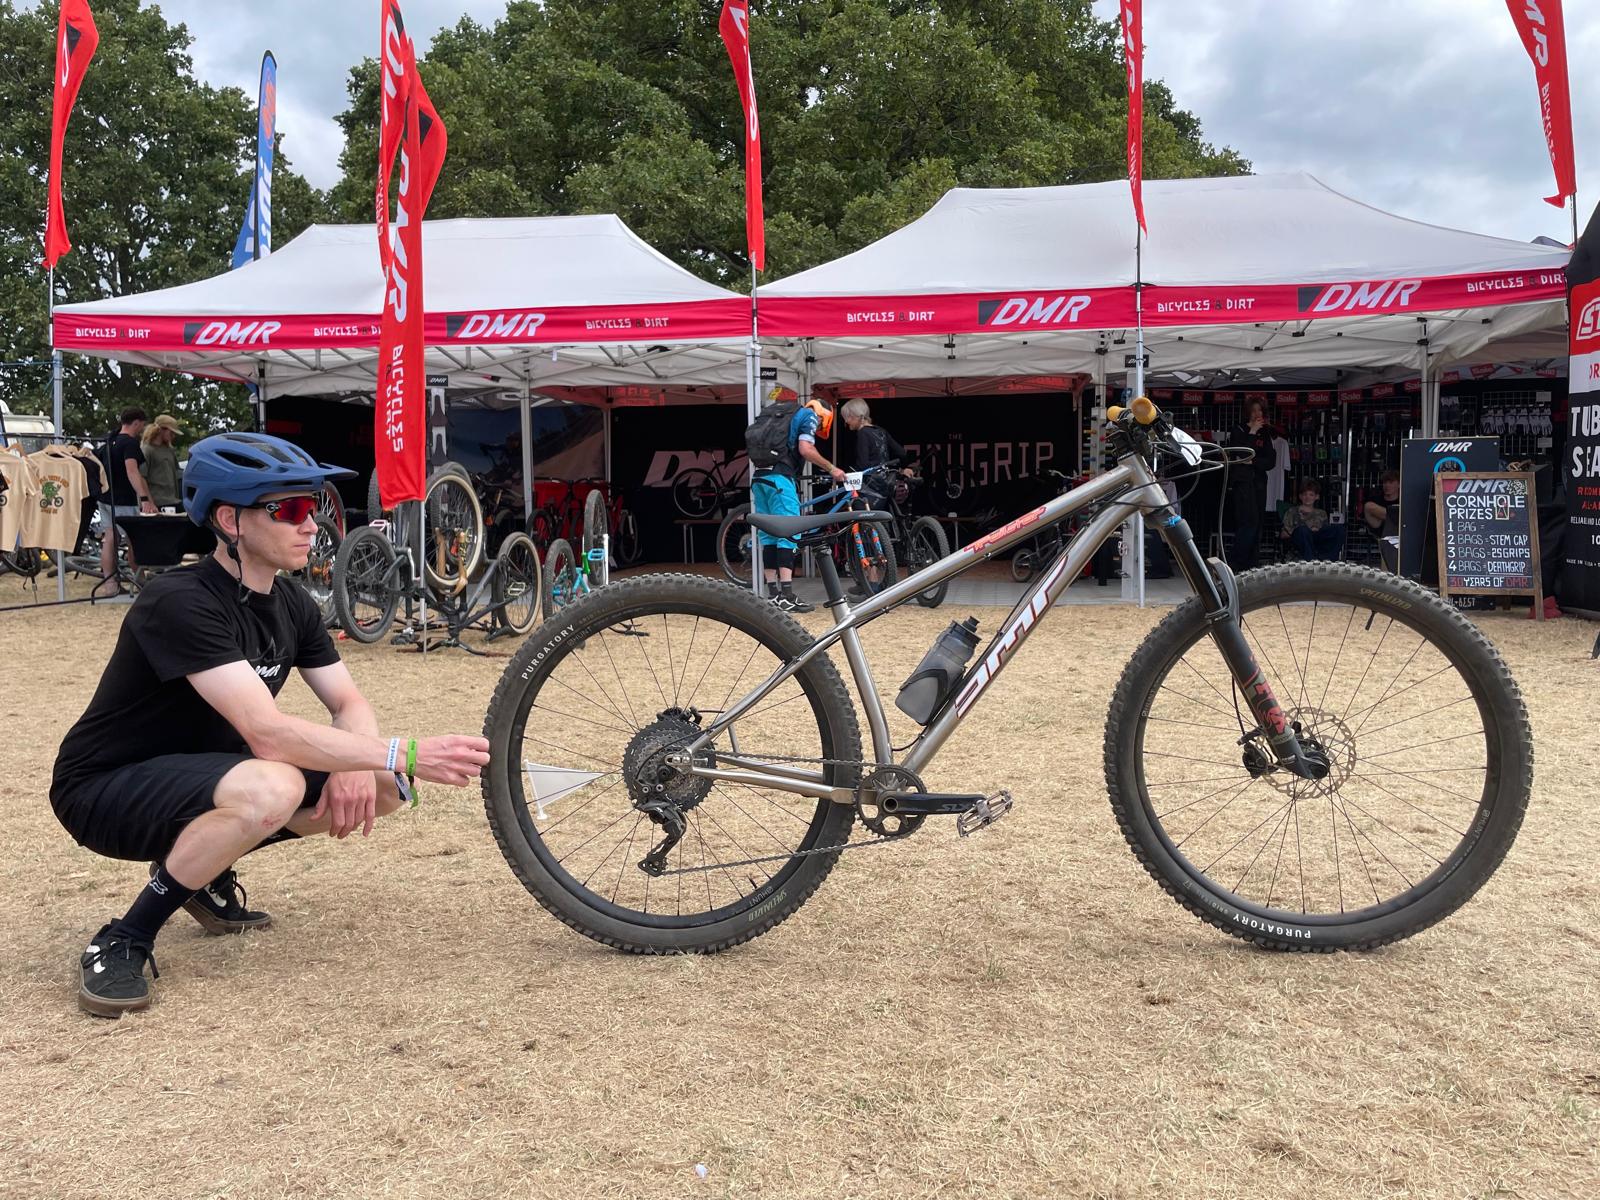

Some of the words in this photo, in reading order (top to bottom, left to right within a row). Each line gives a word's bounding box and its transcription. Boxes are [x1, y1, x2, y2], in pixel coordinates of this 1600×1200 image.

[1467, 277, 1524, 292] BICYCLES
[1313, 280, 1421, 312] DMR
[991, 296, 1091, 325] DMR
[1157, 299, 1210, 312] BICYCLES
[1226, 298, 1255, 310] DIRT
[847, 312, 895, 322] BICYCLES
[908, 311, 935, 321] DIRT
[458, 313, 546, 338] DMR
[585, 318, 632, 330] BICYCLES
[644, 317, 669, 328] DIRT
[75, 327, 117, 337] BICYCLES
[128, 328, 151, 338] DIRT
[195, 321, 281, 345] DMR
[313, 325, 358, 336] BICYCLES
[371, 325, 381, 335] DI
[392, 343, 404, 453] BICYCLES
[1433, 442, 1472, 453] DMR
[643, 450, 749, 487] DM
[1456, 480, 1508, 493] DMR
[1446, 495, 1525, 508] CORNHOLE
[1449, 508, 1493, 520] PRIZES
[1448, 522, 1453, 532] 1
[1457, 522, 1477, 532] BAG
[1447, 534, 1455, 545] 2
[1457, 535, 1484, 545] BAGS
[1489, 535, 1511, 546] STEM
[1513, 535, 1528, 546] CAP
[1447, 547, 1455, 558] 3
[1457, 547, 1486, 559] BAGS
[1448, 560, 1457, 571] 4
[1458, 560, 1481, 572] BAGS
[1487, 561, 1526, 572] DEATHGRIP
[1464, 577, 1490, 587] YEARS
[1493, 577, 1504, 587] OF
[1506, 577, 1528, 587] DMR
[521, 624, 575, 680] PURGATORY
[1233, 913, 1312, 939] PURGATORY
